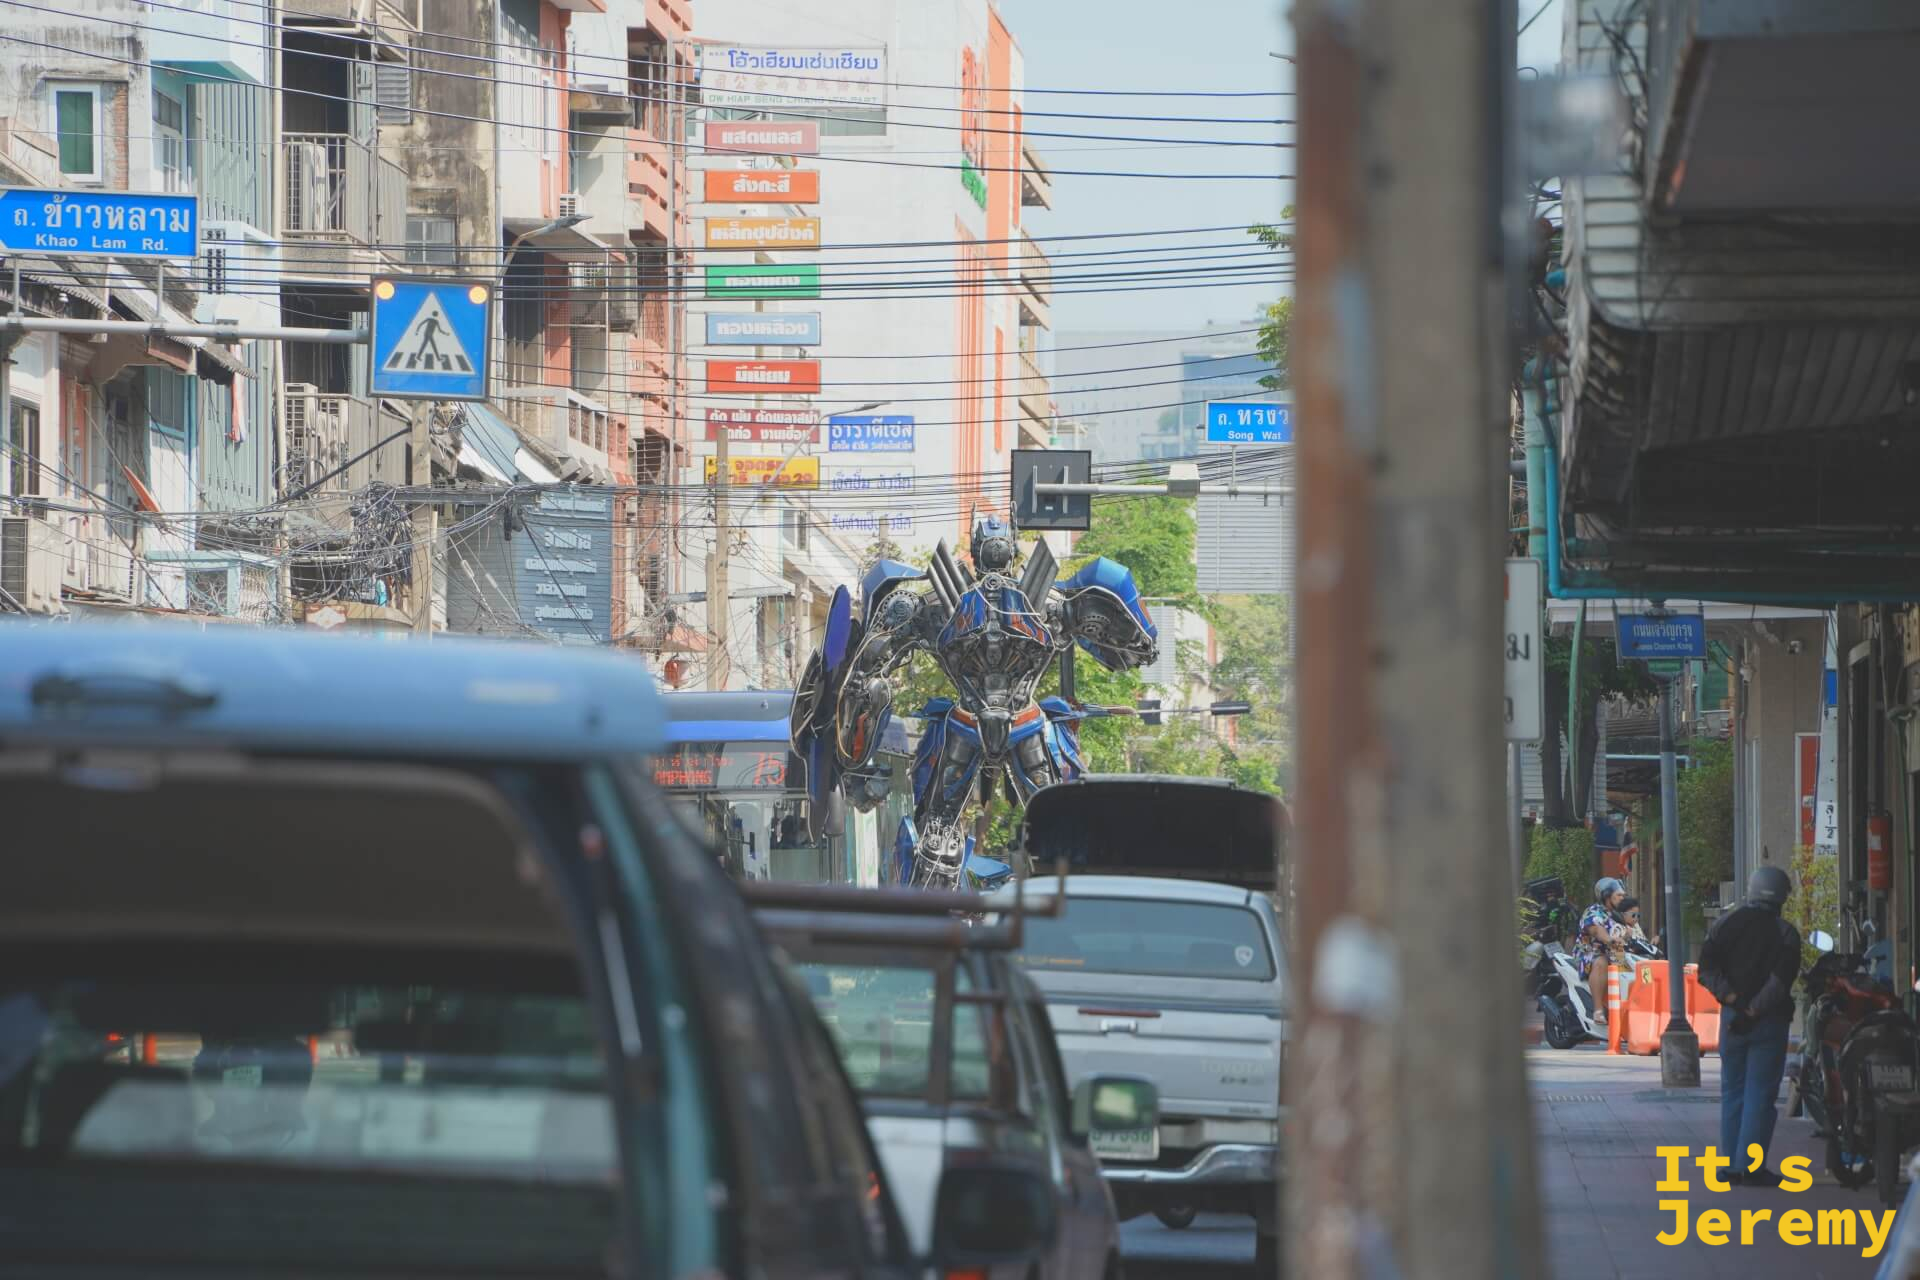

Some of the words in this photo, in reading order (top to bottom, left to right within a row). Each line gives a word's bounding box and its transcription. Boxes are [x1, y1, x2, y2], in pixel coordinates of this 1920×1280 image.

[727, 95, 751, 103] HIAP
[733, 174, 791, 192] สังกะสี
[14, 208, 36, 227] ถ.
[44, 195, 190, 233] ข้าวหลาม
[35, 233, 79, 248] Khao
[92, 235, 127, 249] Lam
[142, 238, 169, 251] Rd.
[1217, 413, 1232, 426] ถ.
[1227, 430, 1254, 442] Song
[1262, 431, 1281, 441] Wat
[1633, 622, 1693, 642] ถนนเจริญกรุง
